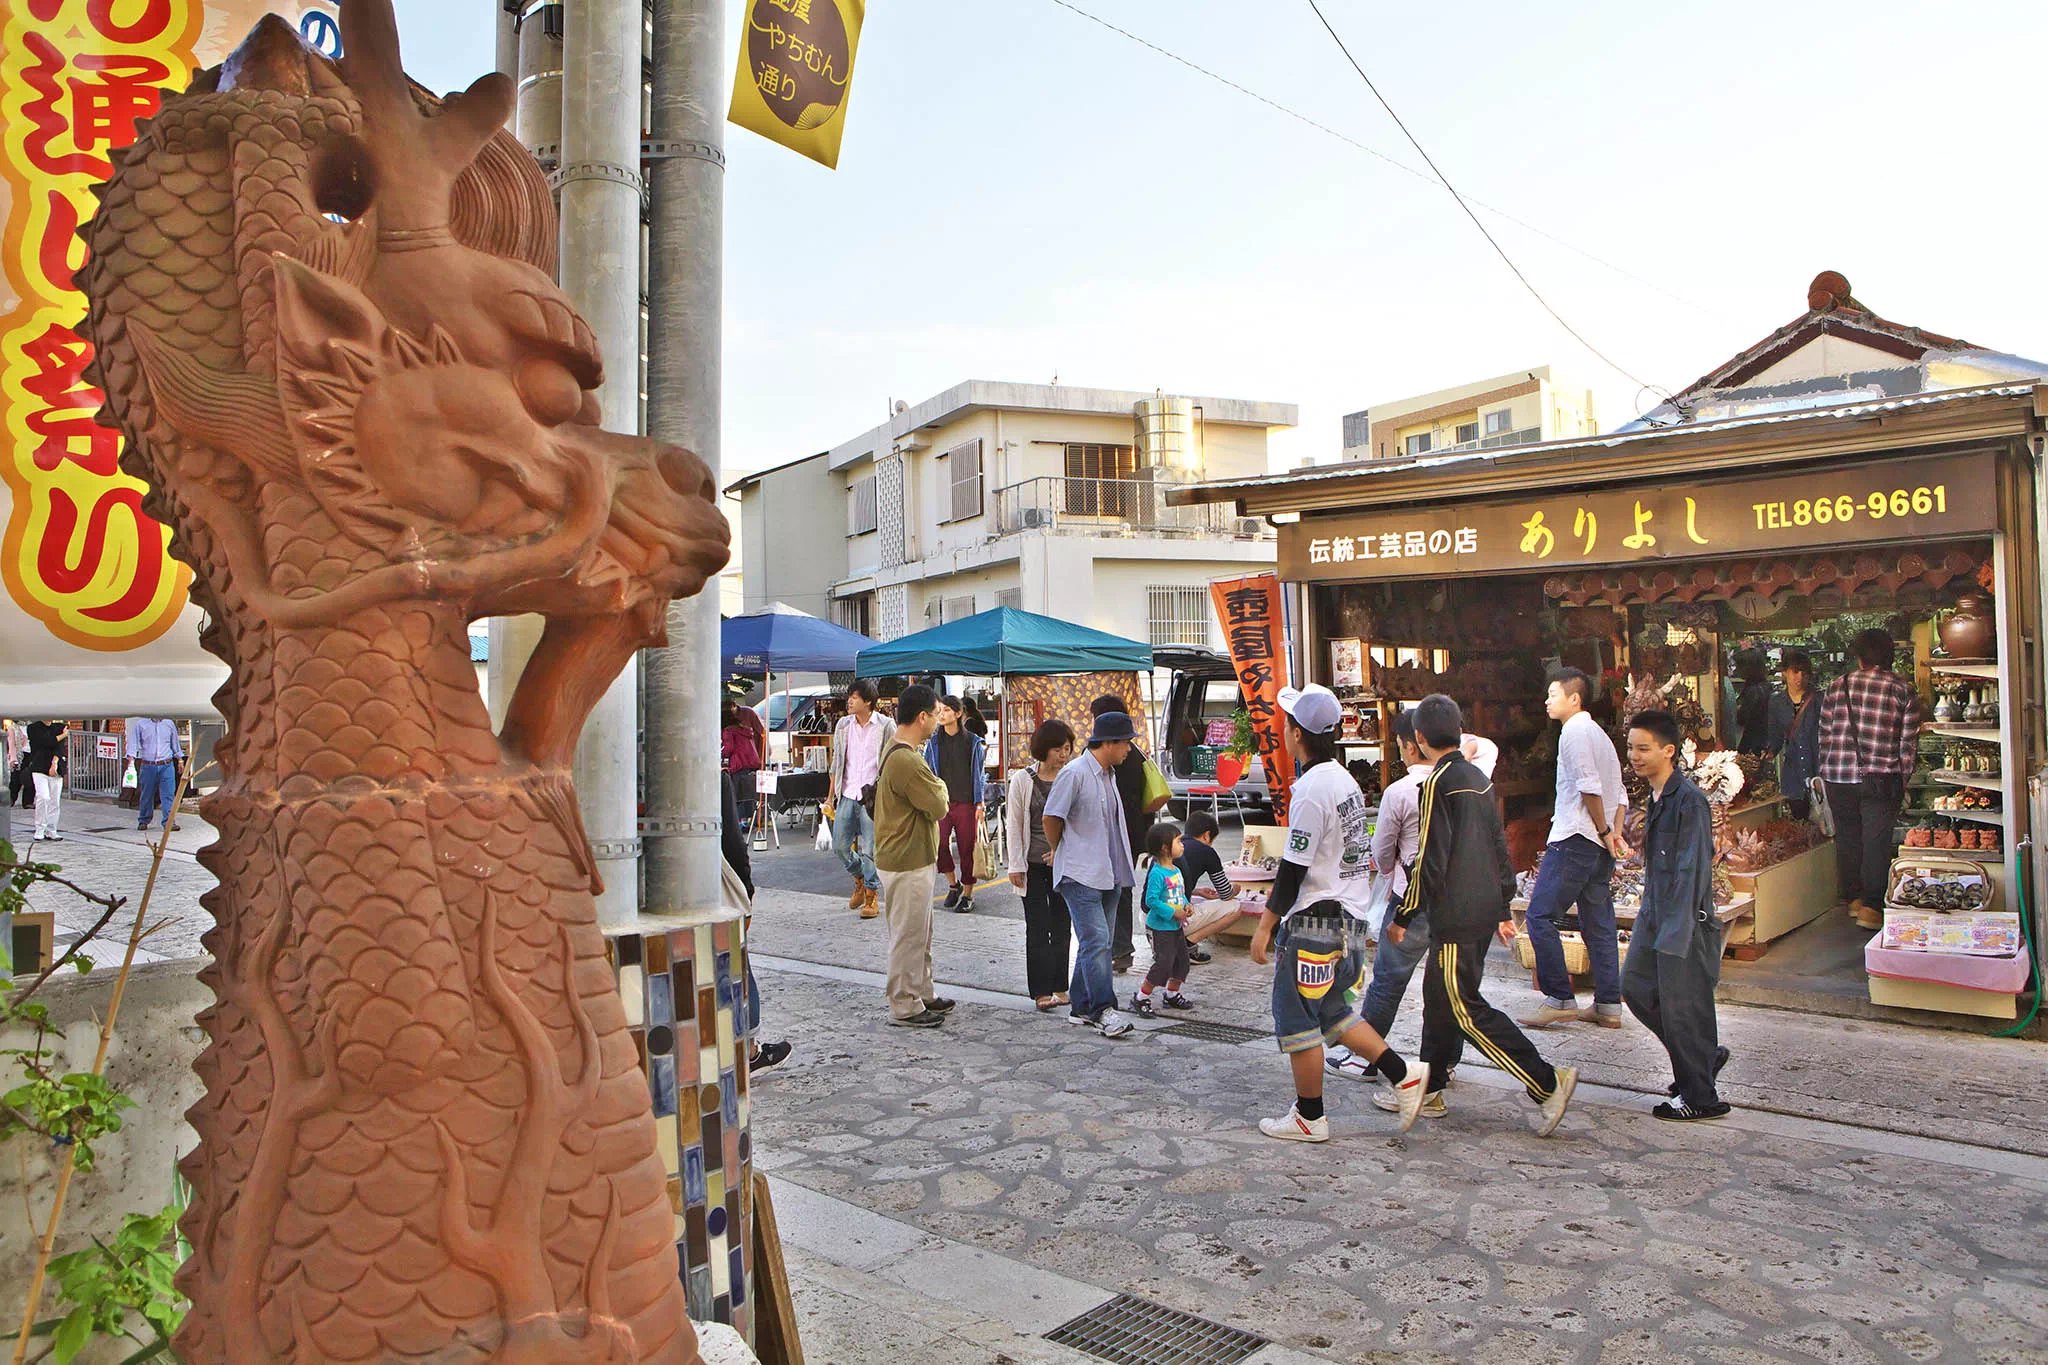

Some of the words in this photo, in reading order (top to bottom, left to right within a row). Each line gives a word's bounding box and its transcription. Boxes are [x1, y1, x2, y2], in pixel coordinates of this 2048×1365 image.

[764, 21, 848, 86] やちむん
[757, 61, 796, 101] 通り
[1519, 496, 1709, 559] ありよし
[1753, 484, 1947, 530] TEL866-9661
[1308, 526, 1478, 563] 伝統工芸品の店
